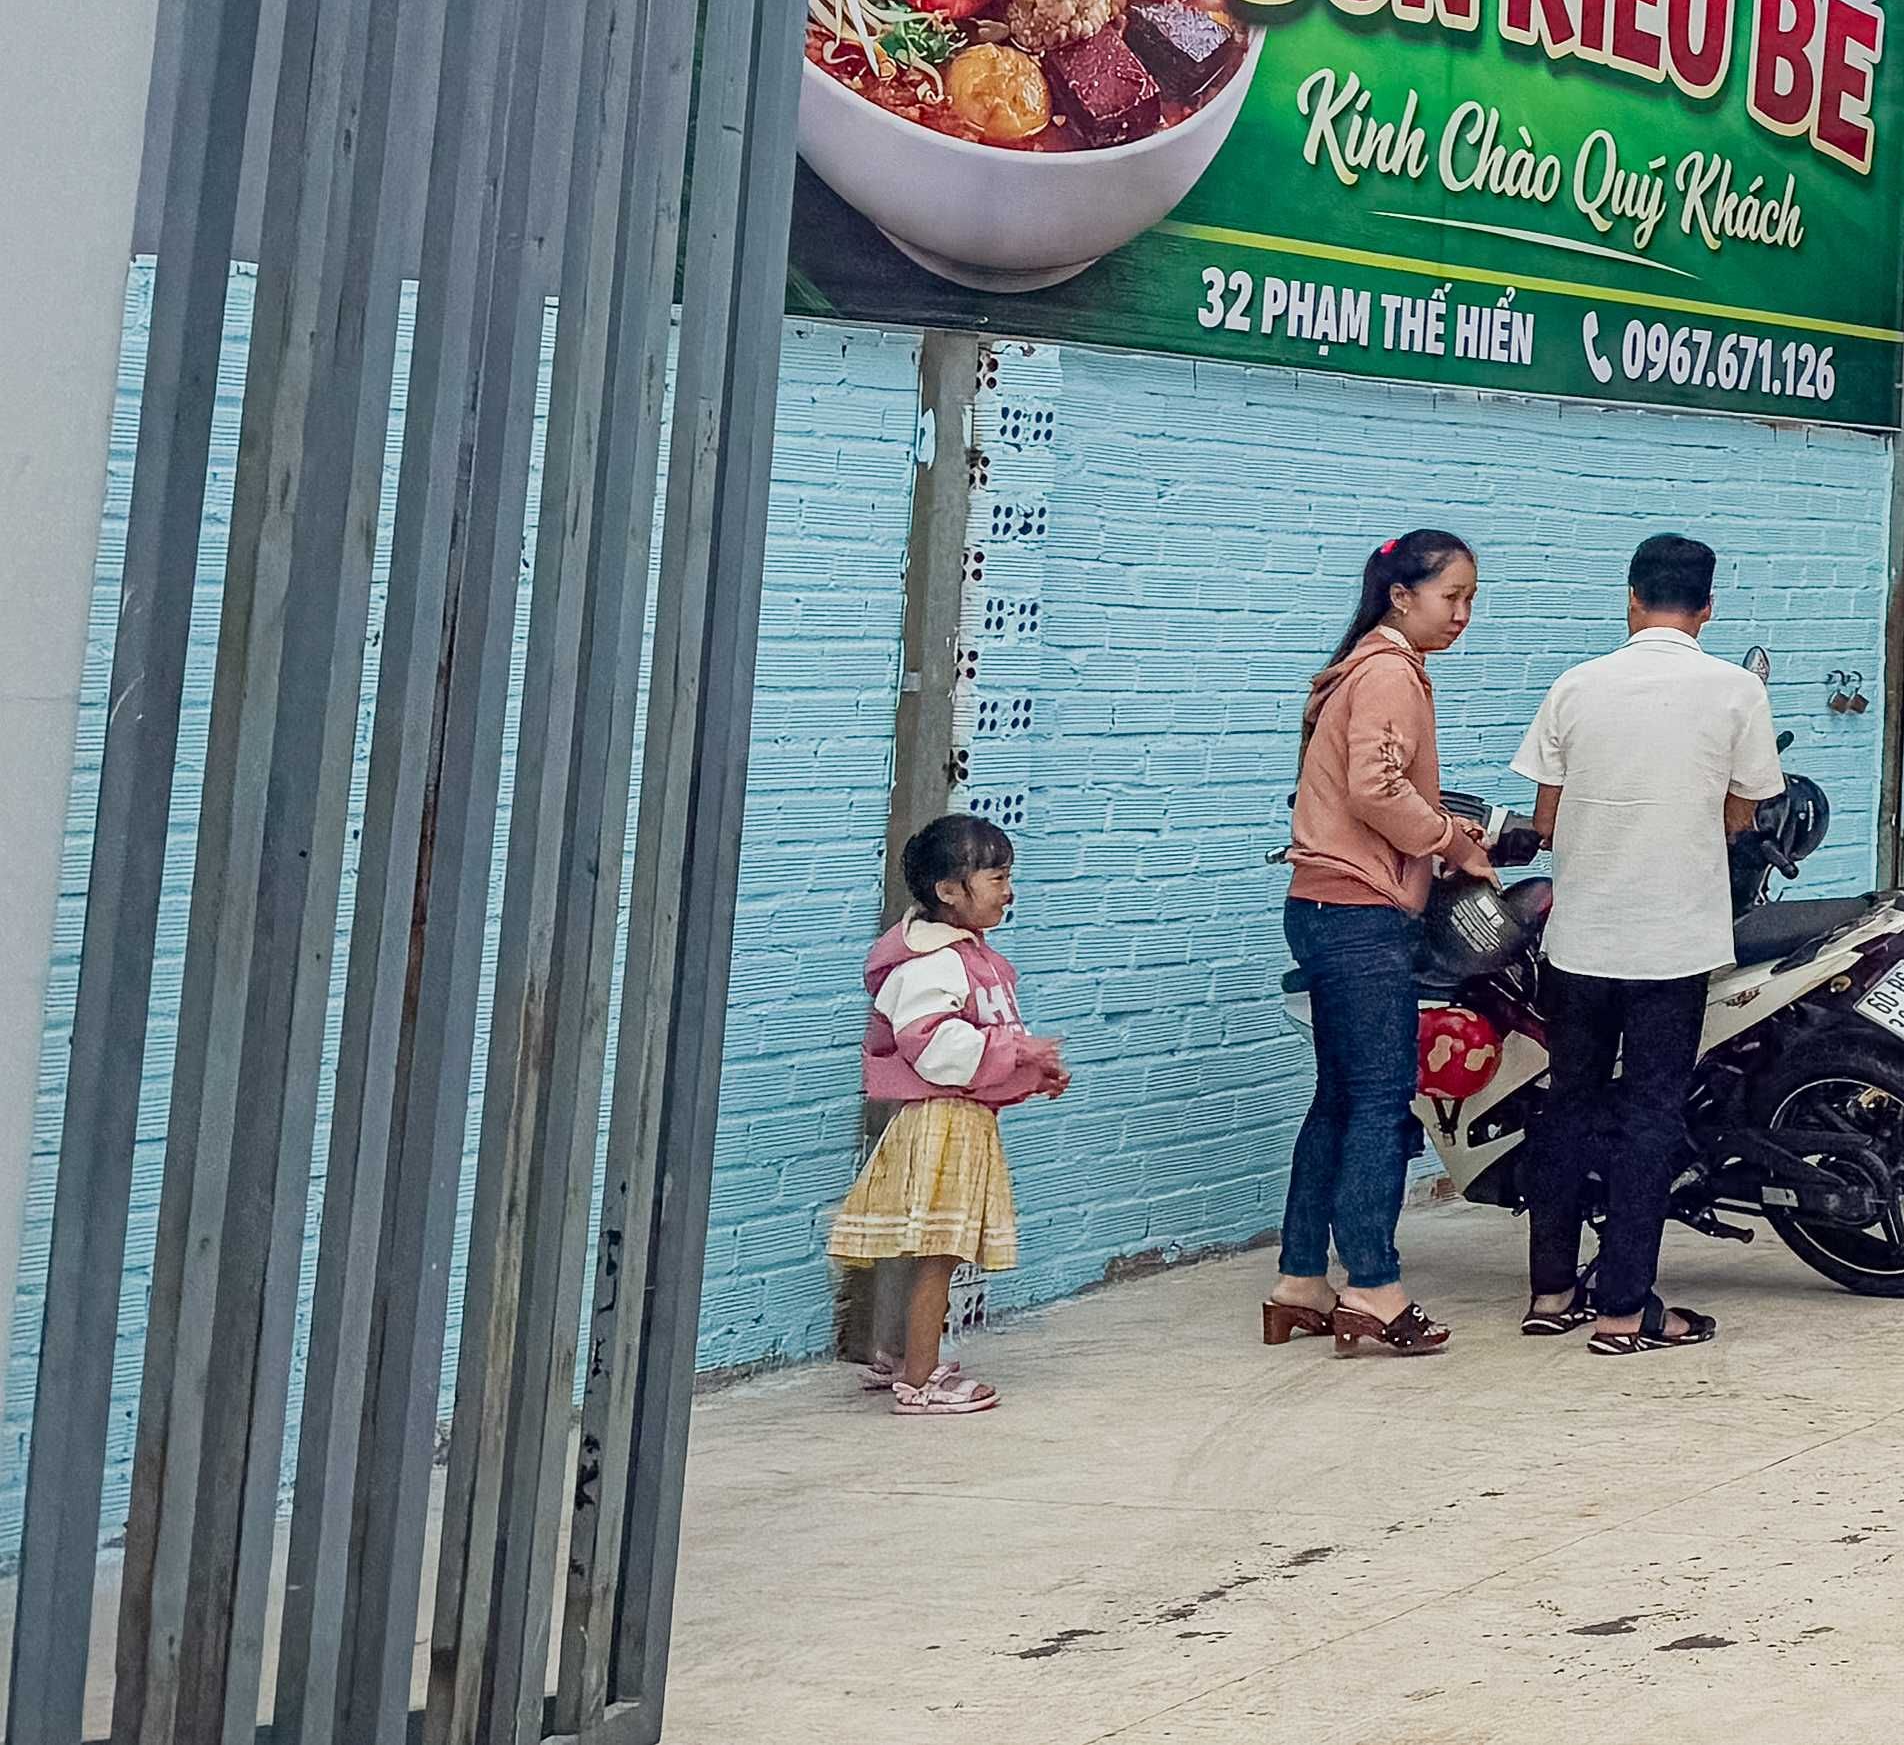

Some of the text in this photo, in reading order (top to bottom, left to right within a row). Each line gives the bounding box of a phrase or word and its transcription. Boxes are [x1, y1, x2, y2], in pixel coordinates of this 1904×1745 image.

[1438, 100, 1562, 203] Chào
[1572, 129, 1666, 250] Quý
[1675, 150, 1805, 251] Khách
[1198, 265, 1837, 402] 32 PHẠM THẾ HIỂN 0967.671.126
